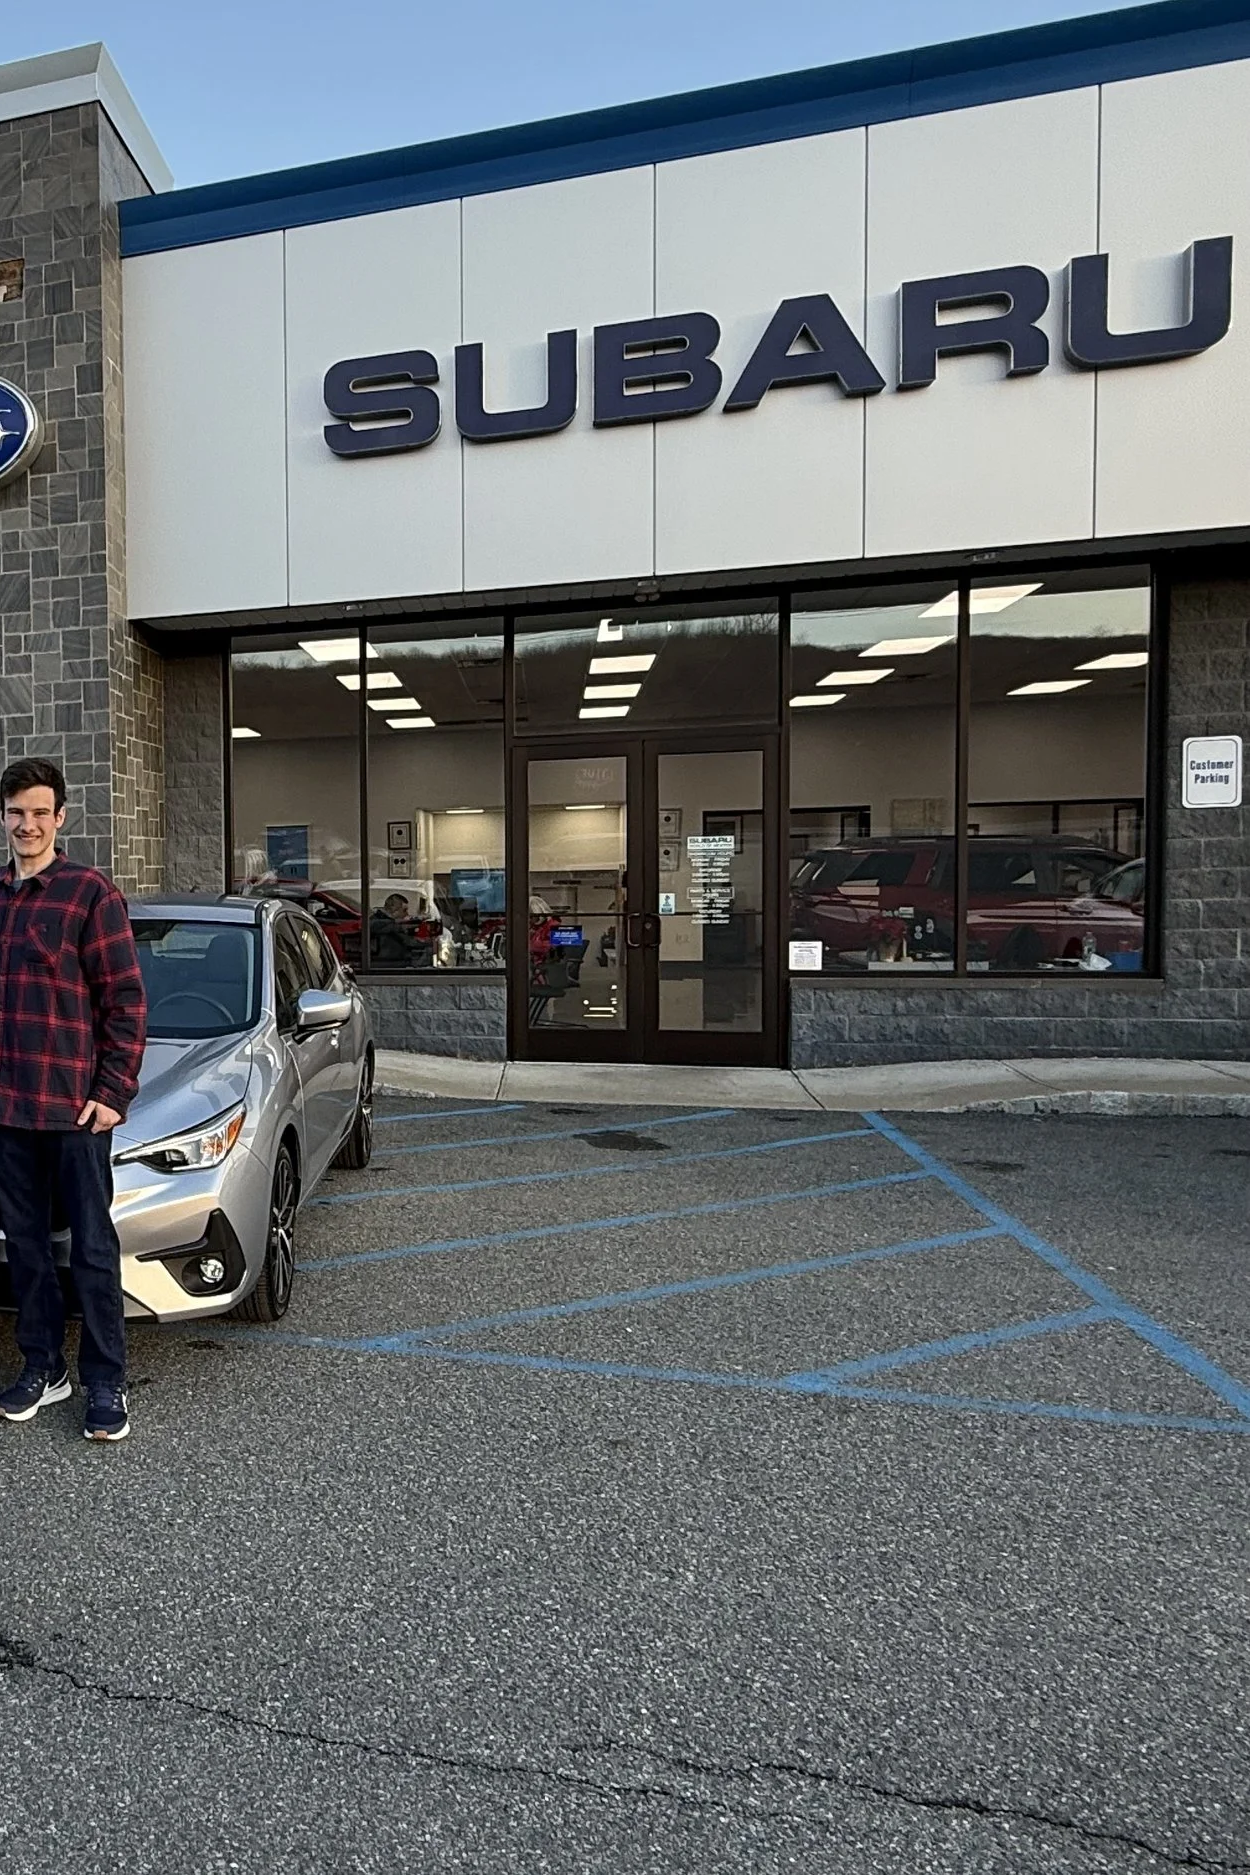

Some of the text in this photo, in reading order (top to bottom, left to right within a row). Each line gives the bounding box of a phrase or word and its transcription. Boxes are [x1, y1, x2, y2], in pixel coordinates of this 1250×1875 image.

[323, 236, 1233, 458] SUBARU
[1190, 760, 1234, 770] Customer
[1194, 773, 1230, 784] Parking
